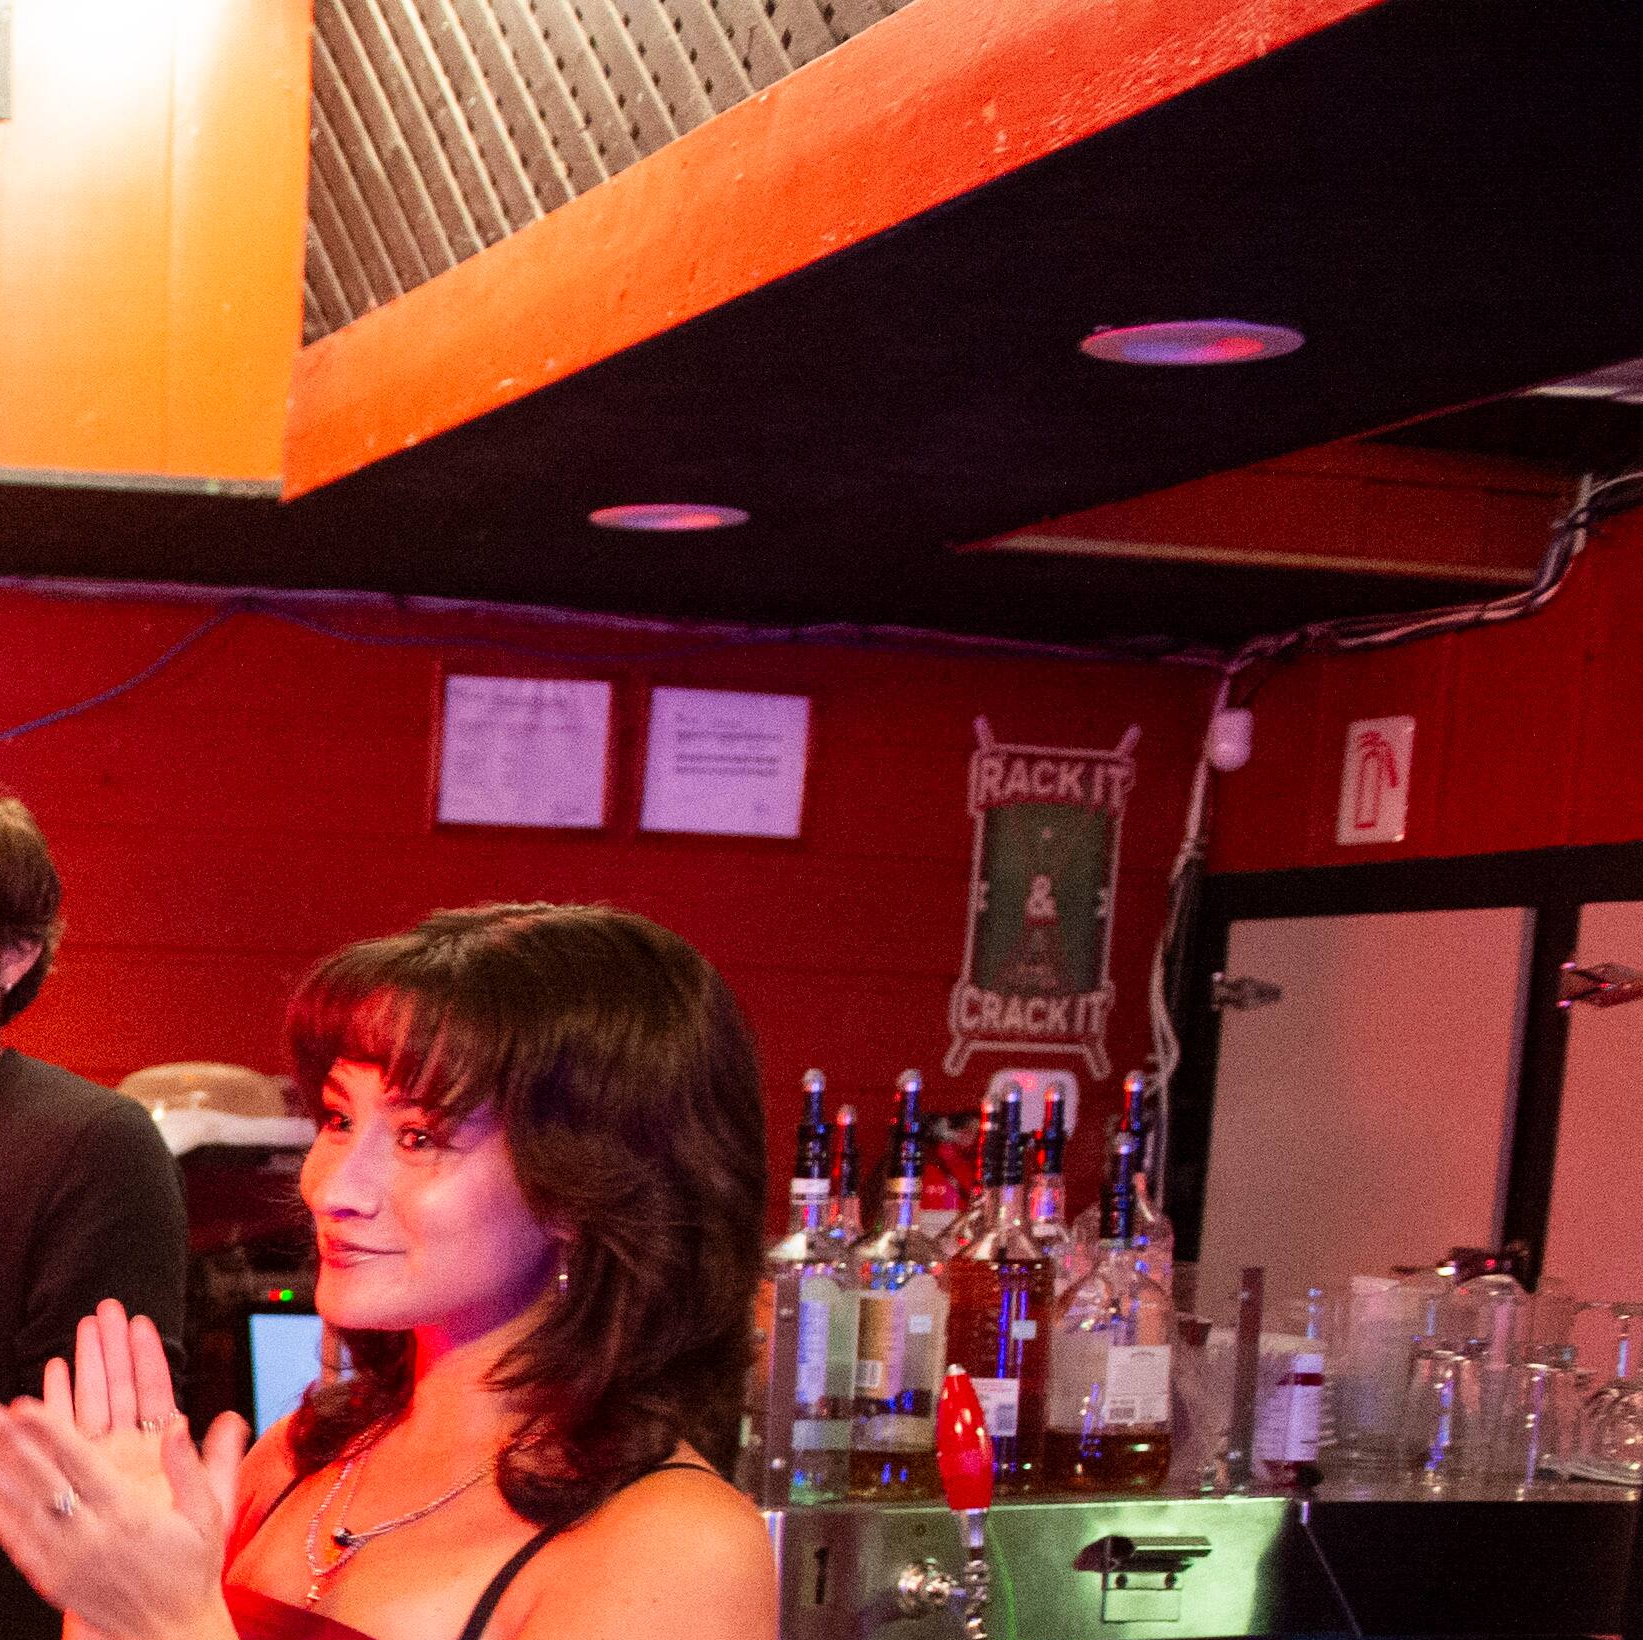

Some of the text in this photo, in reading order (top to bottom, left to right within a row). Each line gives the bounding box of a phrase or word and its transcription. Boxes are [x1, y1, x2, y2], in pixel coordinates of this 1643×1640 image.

[979, 756, 1130, 813] RACK IT
[1025, 875, 1056, 917] &
[959, 986, 1109, 1034] CRACK IT
